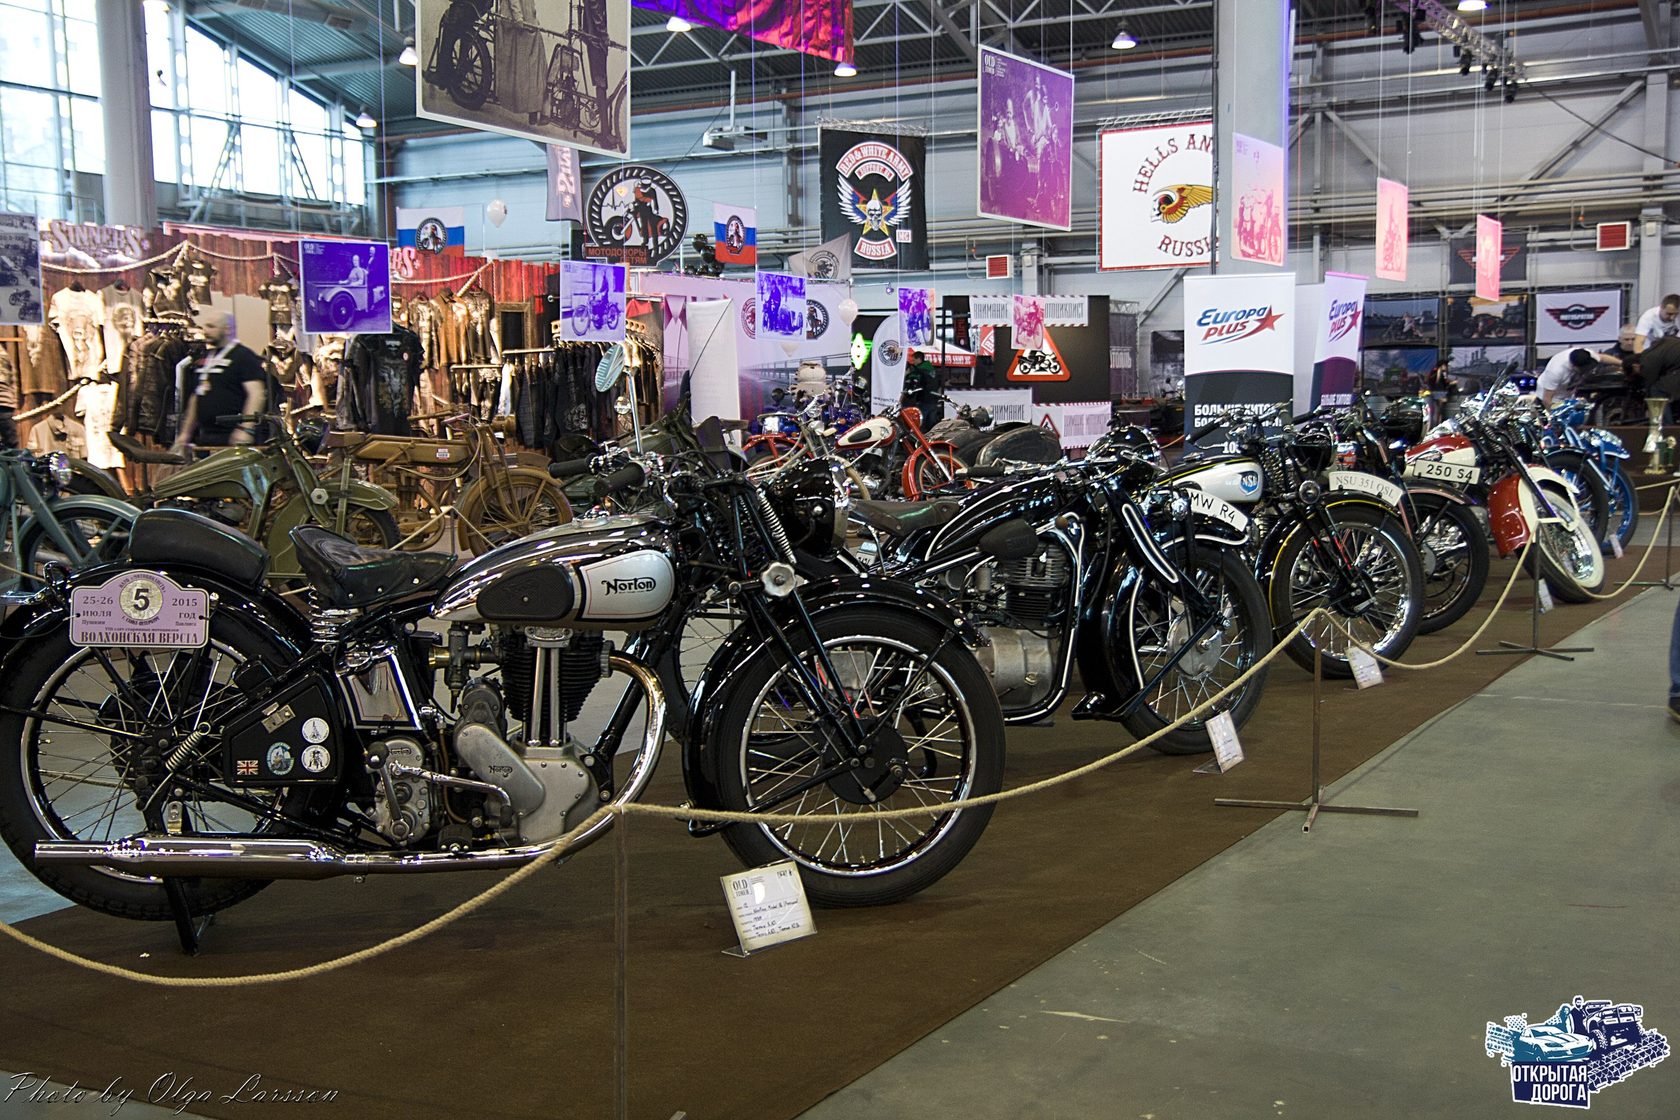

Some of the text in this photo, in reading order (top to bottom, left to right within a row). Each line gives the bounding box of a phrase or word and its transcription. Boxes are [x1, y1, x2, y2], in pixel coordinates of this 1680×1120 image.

[888, 150, 910, 179] ARMY
[1132, 134, 1214, 194] HELLS AN
[861, 243, 891, 257] RUSSIA
[974, 303, 1008, 319] ВНИМАНИЕ
[1196, 306, 1268, 327] Europa
[1426, 464, 1473, 480] 250 S4
[1336, 475, 1356, 487] NSU
[1359, 477, 1374, 490] 351
[1219, 503, 1236, 523] R4
[601, 577, 656, 596] Norton
[83, 595, 114, 605] 25-26
[133, 588, 150, 611] 5
[172, 598, 198, 607] 2015
[81, 631, 198, 644] ВОЛХОНСКАЯ ВЕРСТА
[488, 765, 513, 774] Norton
[733, 878, 748, 890] OLD
